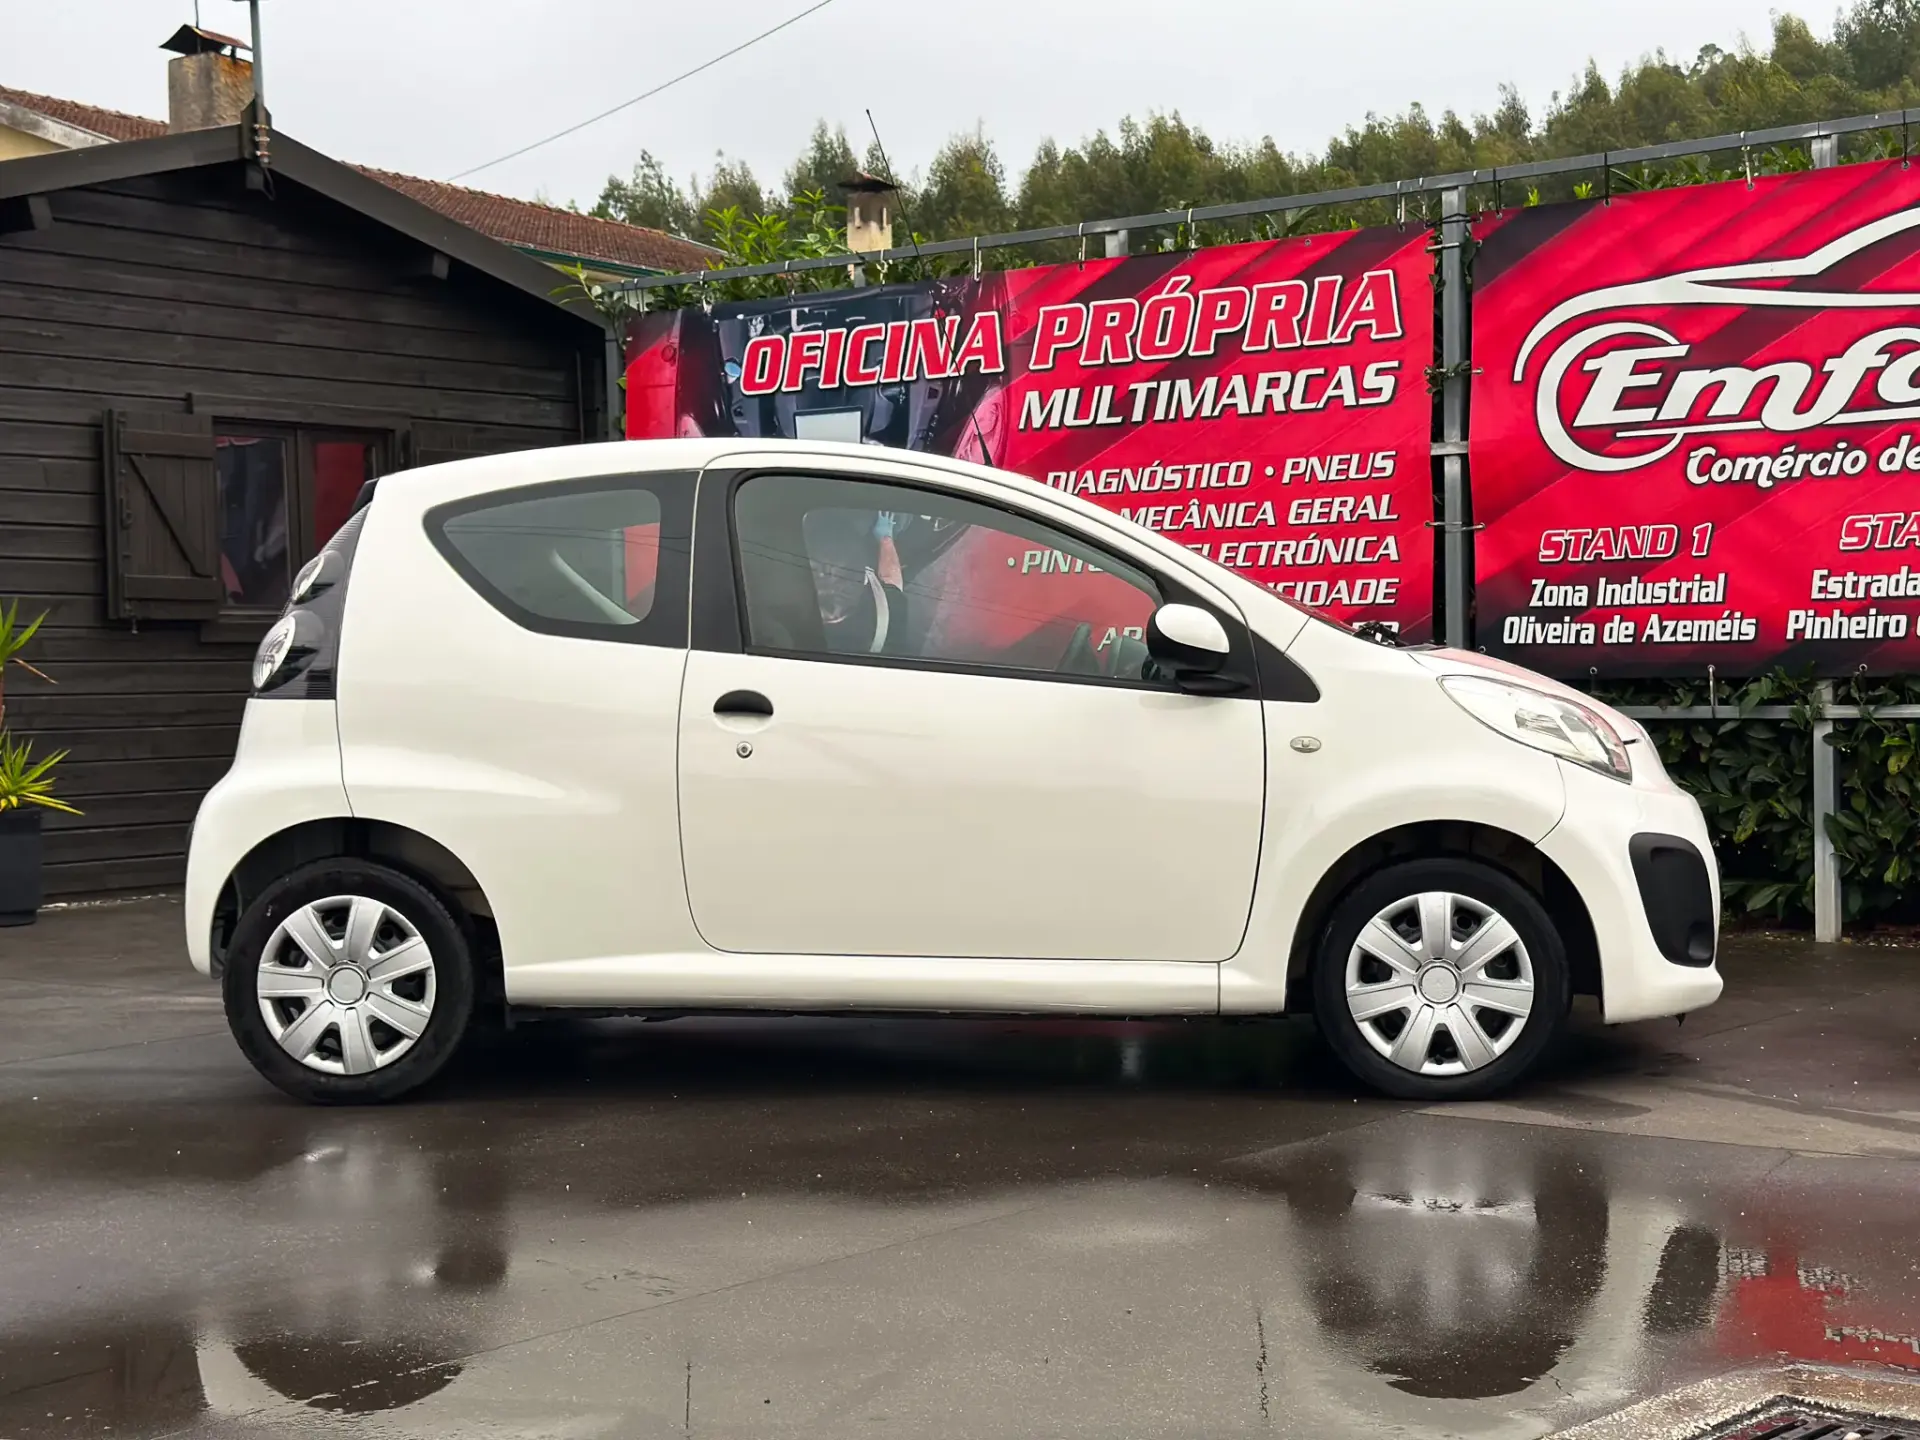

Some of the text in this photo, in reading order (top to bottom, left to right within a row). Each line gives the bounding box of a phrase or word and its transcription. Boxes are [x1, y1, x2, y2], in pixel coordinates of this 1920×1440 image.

[741, 270, 1402, 395] OFICINA PRÓPRIA
[1018, 361, 1399, 431] MULTIMARCAS
[1046, 450, 1397, 495] DIAGNÓSTICO PNEUS
[1686, 435, 1920, 488] Comércio de
[1288, 494, 1400, 525] GERAL
[1022, 533, 1399, 574] PIN ECTRÓNICA
[1539, 522, 1713, 563] STAND 1
[1267, 578, 1399, 606] IDADE
[1529, 573, 1726, 607] Zona Industrial
[1811, 565, 1920, 600] Estrada
[1503, 610, 1757, 645] Oliveira de Azeméis
[1786, 608, 1908, 640] Pinheiro
